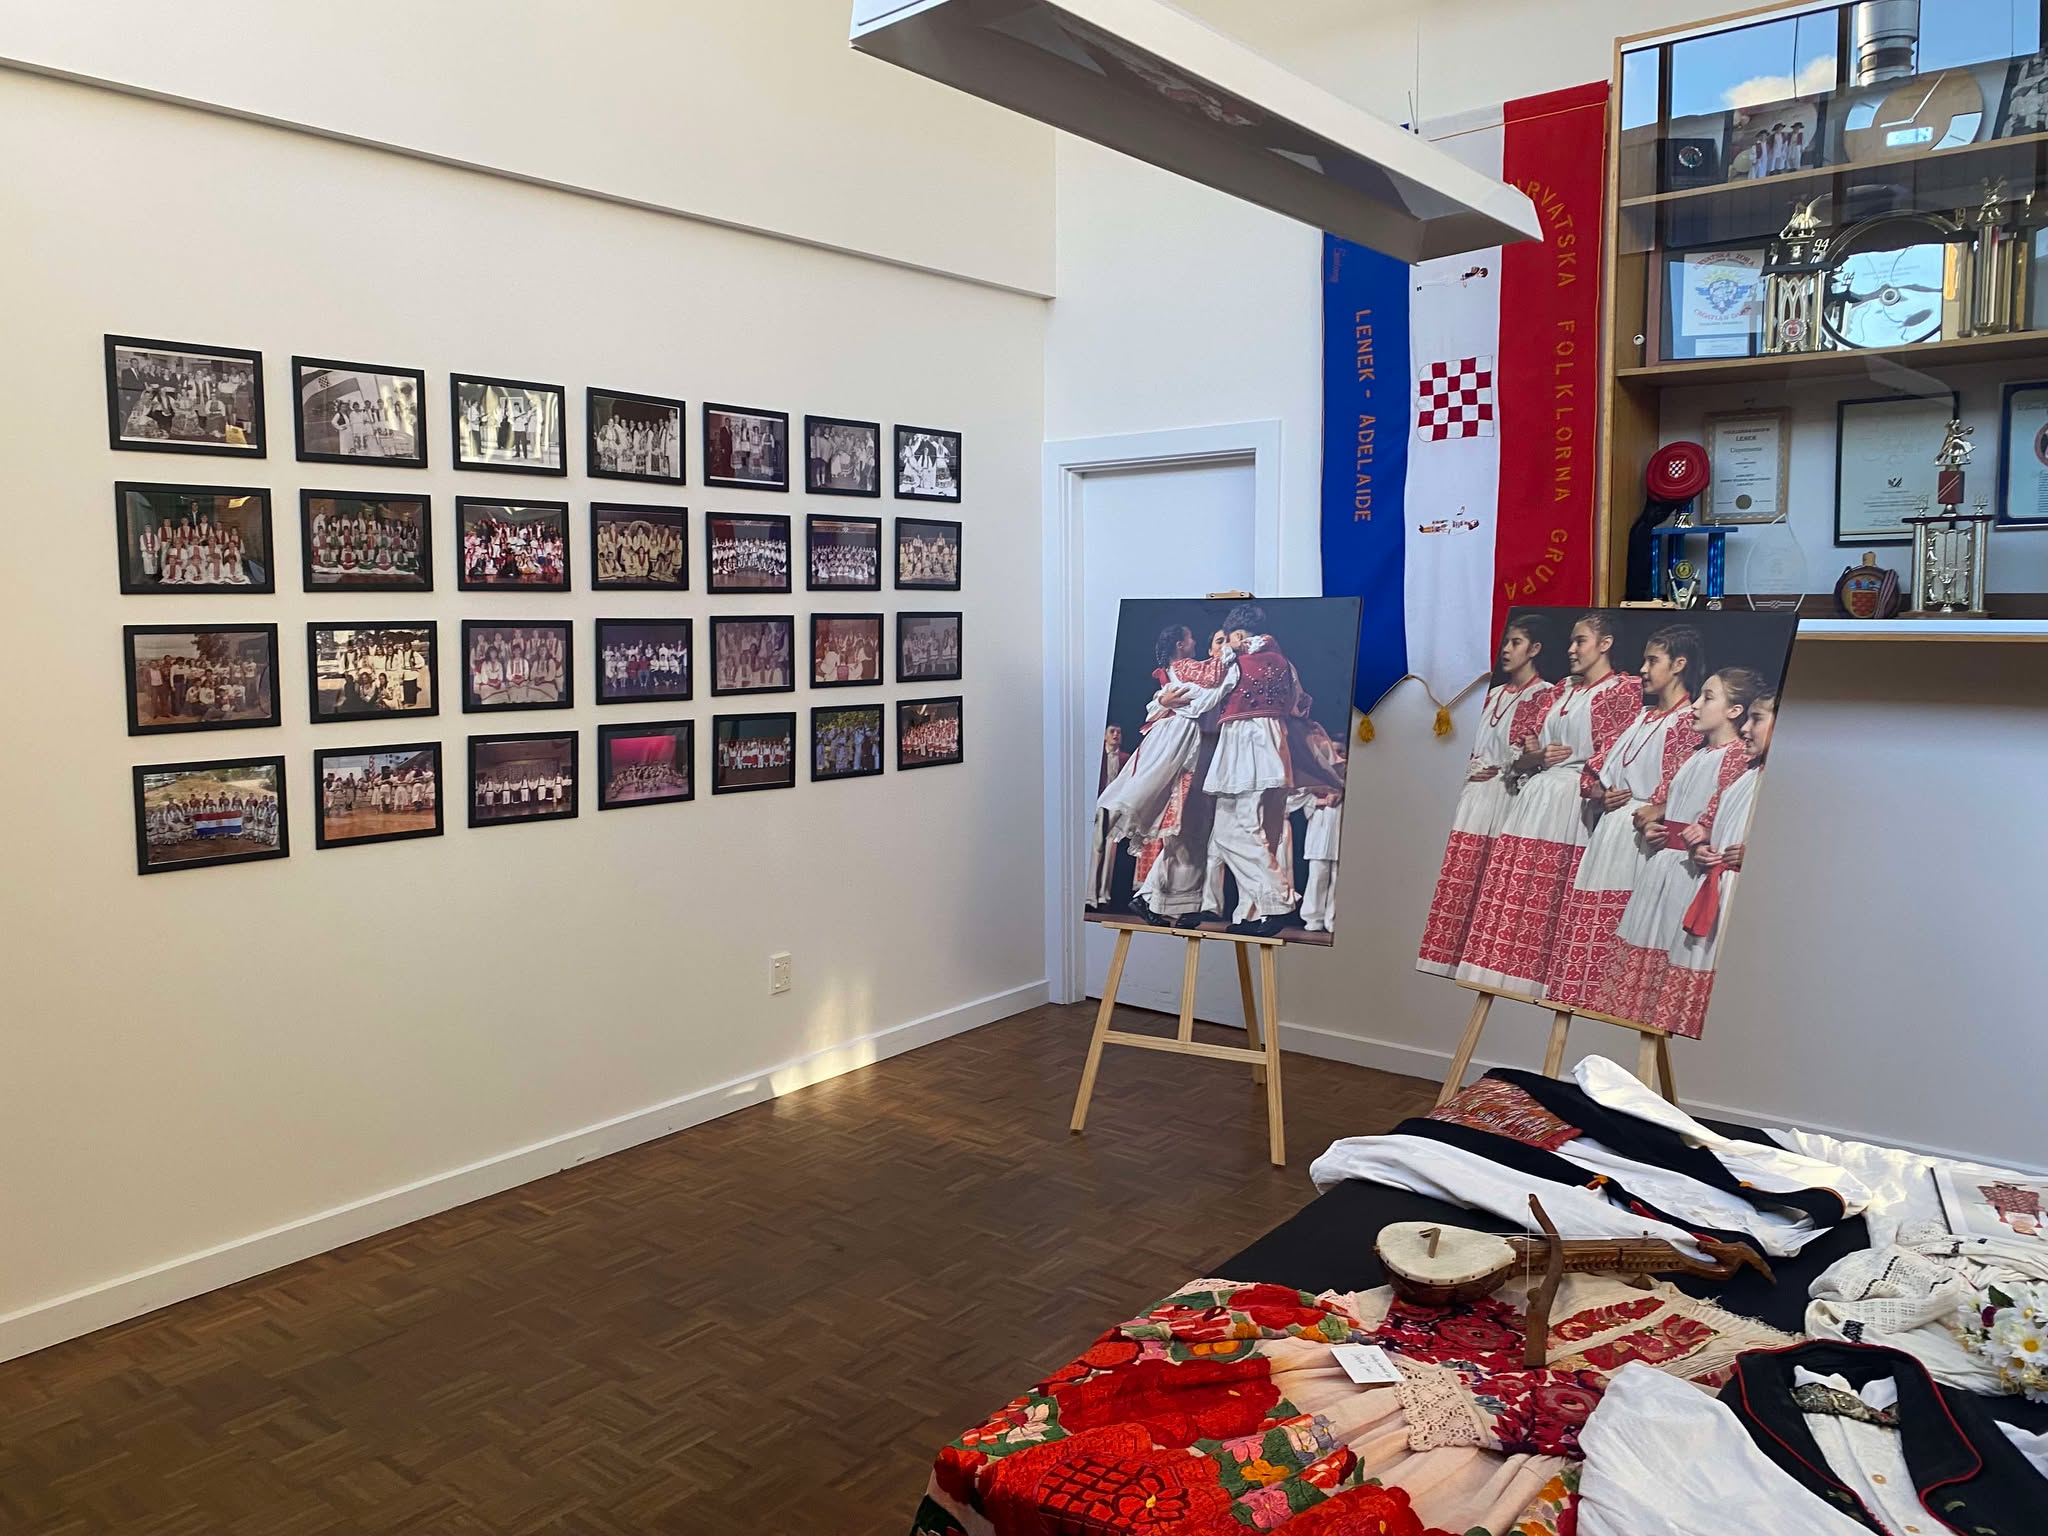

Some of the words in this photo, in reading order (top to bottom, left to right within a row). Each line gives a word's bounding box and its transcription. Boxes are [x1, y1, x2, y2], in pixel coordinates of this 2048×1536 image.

[1516, 179, 1577, 287] RVATSKA
[1354, 309, 1375, 383] LENEK
[1554, 319, 1575, 502] FOLKLORNA
[1354, 413, 1376, 522] ADELAIDE
[1504, 528, 1568, 600] GRUPA
